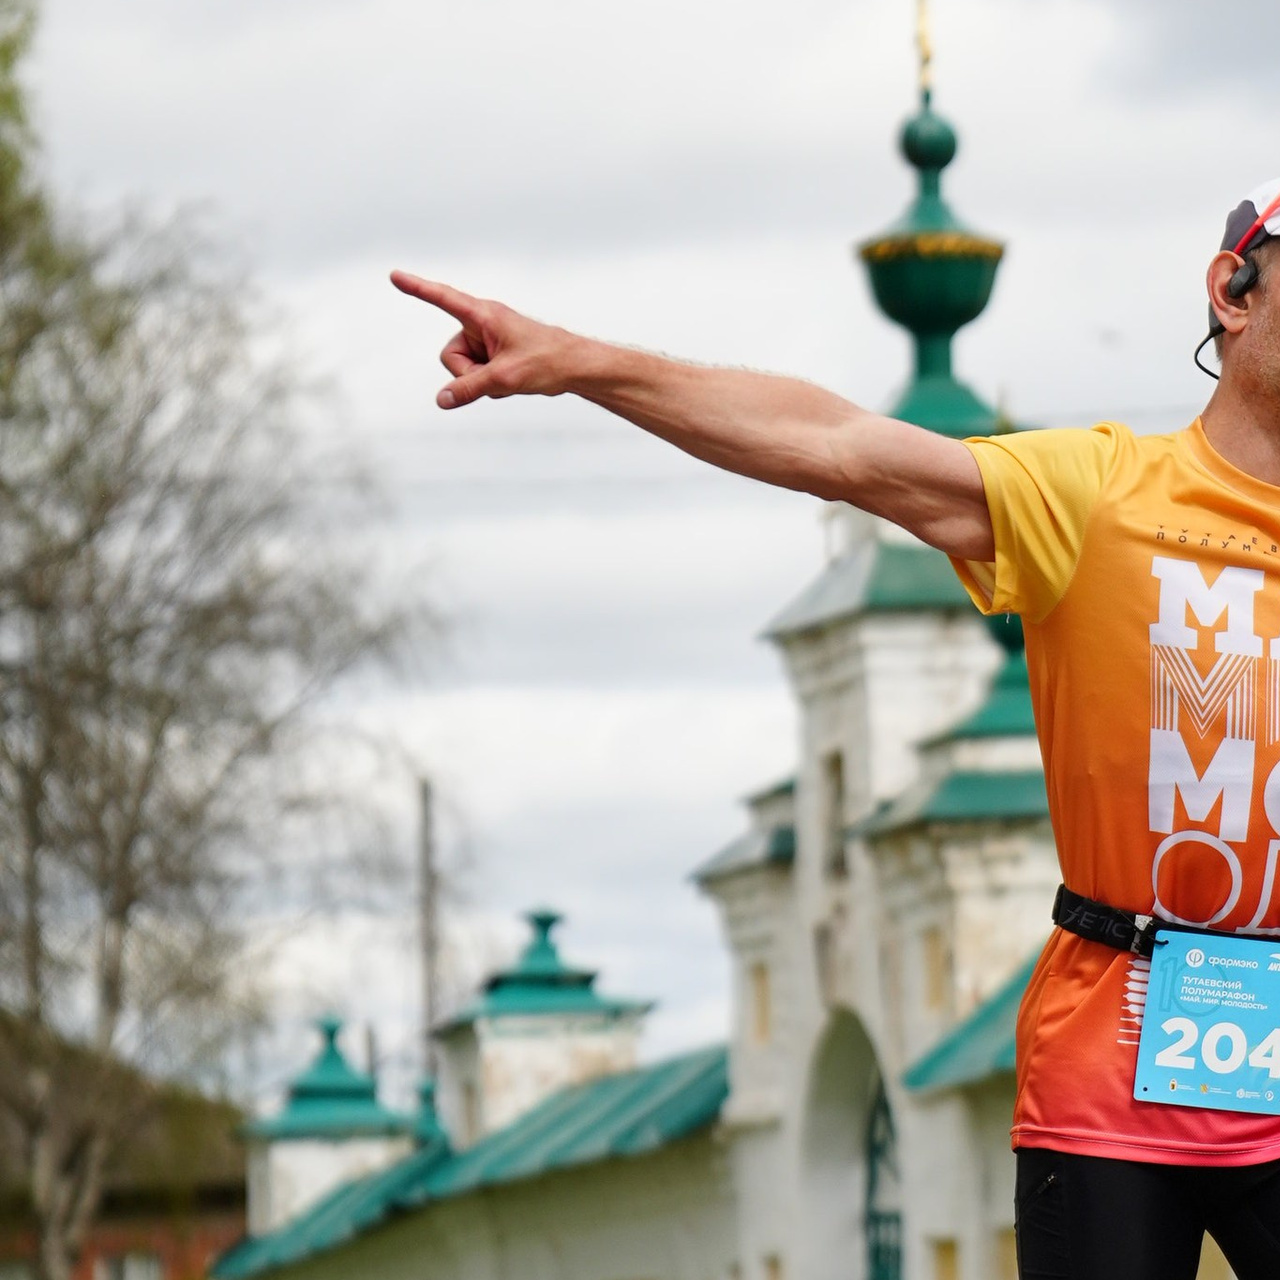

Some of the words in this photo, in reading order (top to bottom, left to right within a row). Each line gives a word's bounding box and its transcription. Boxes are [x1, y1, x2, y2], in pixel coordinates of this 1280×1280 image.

[1208, 956, 1259, 969] фармэко
[1182, 975, 1242, 989] ТУТАЕВСКИЙ
[1180, 986, 1255, 1001] ПОЛУМАРАФОН
